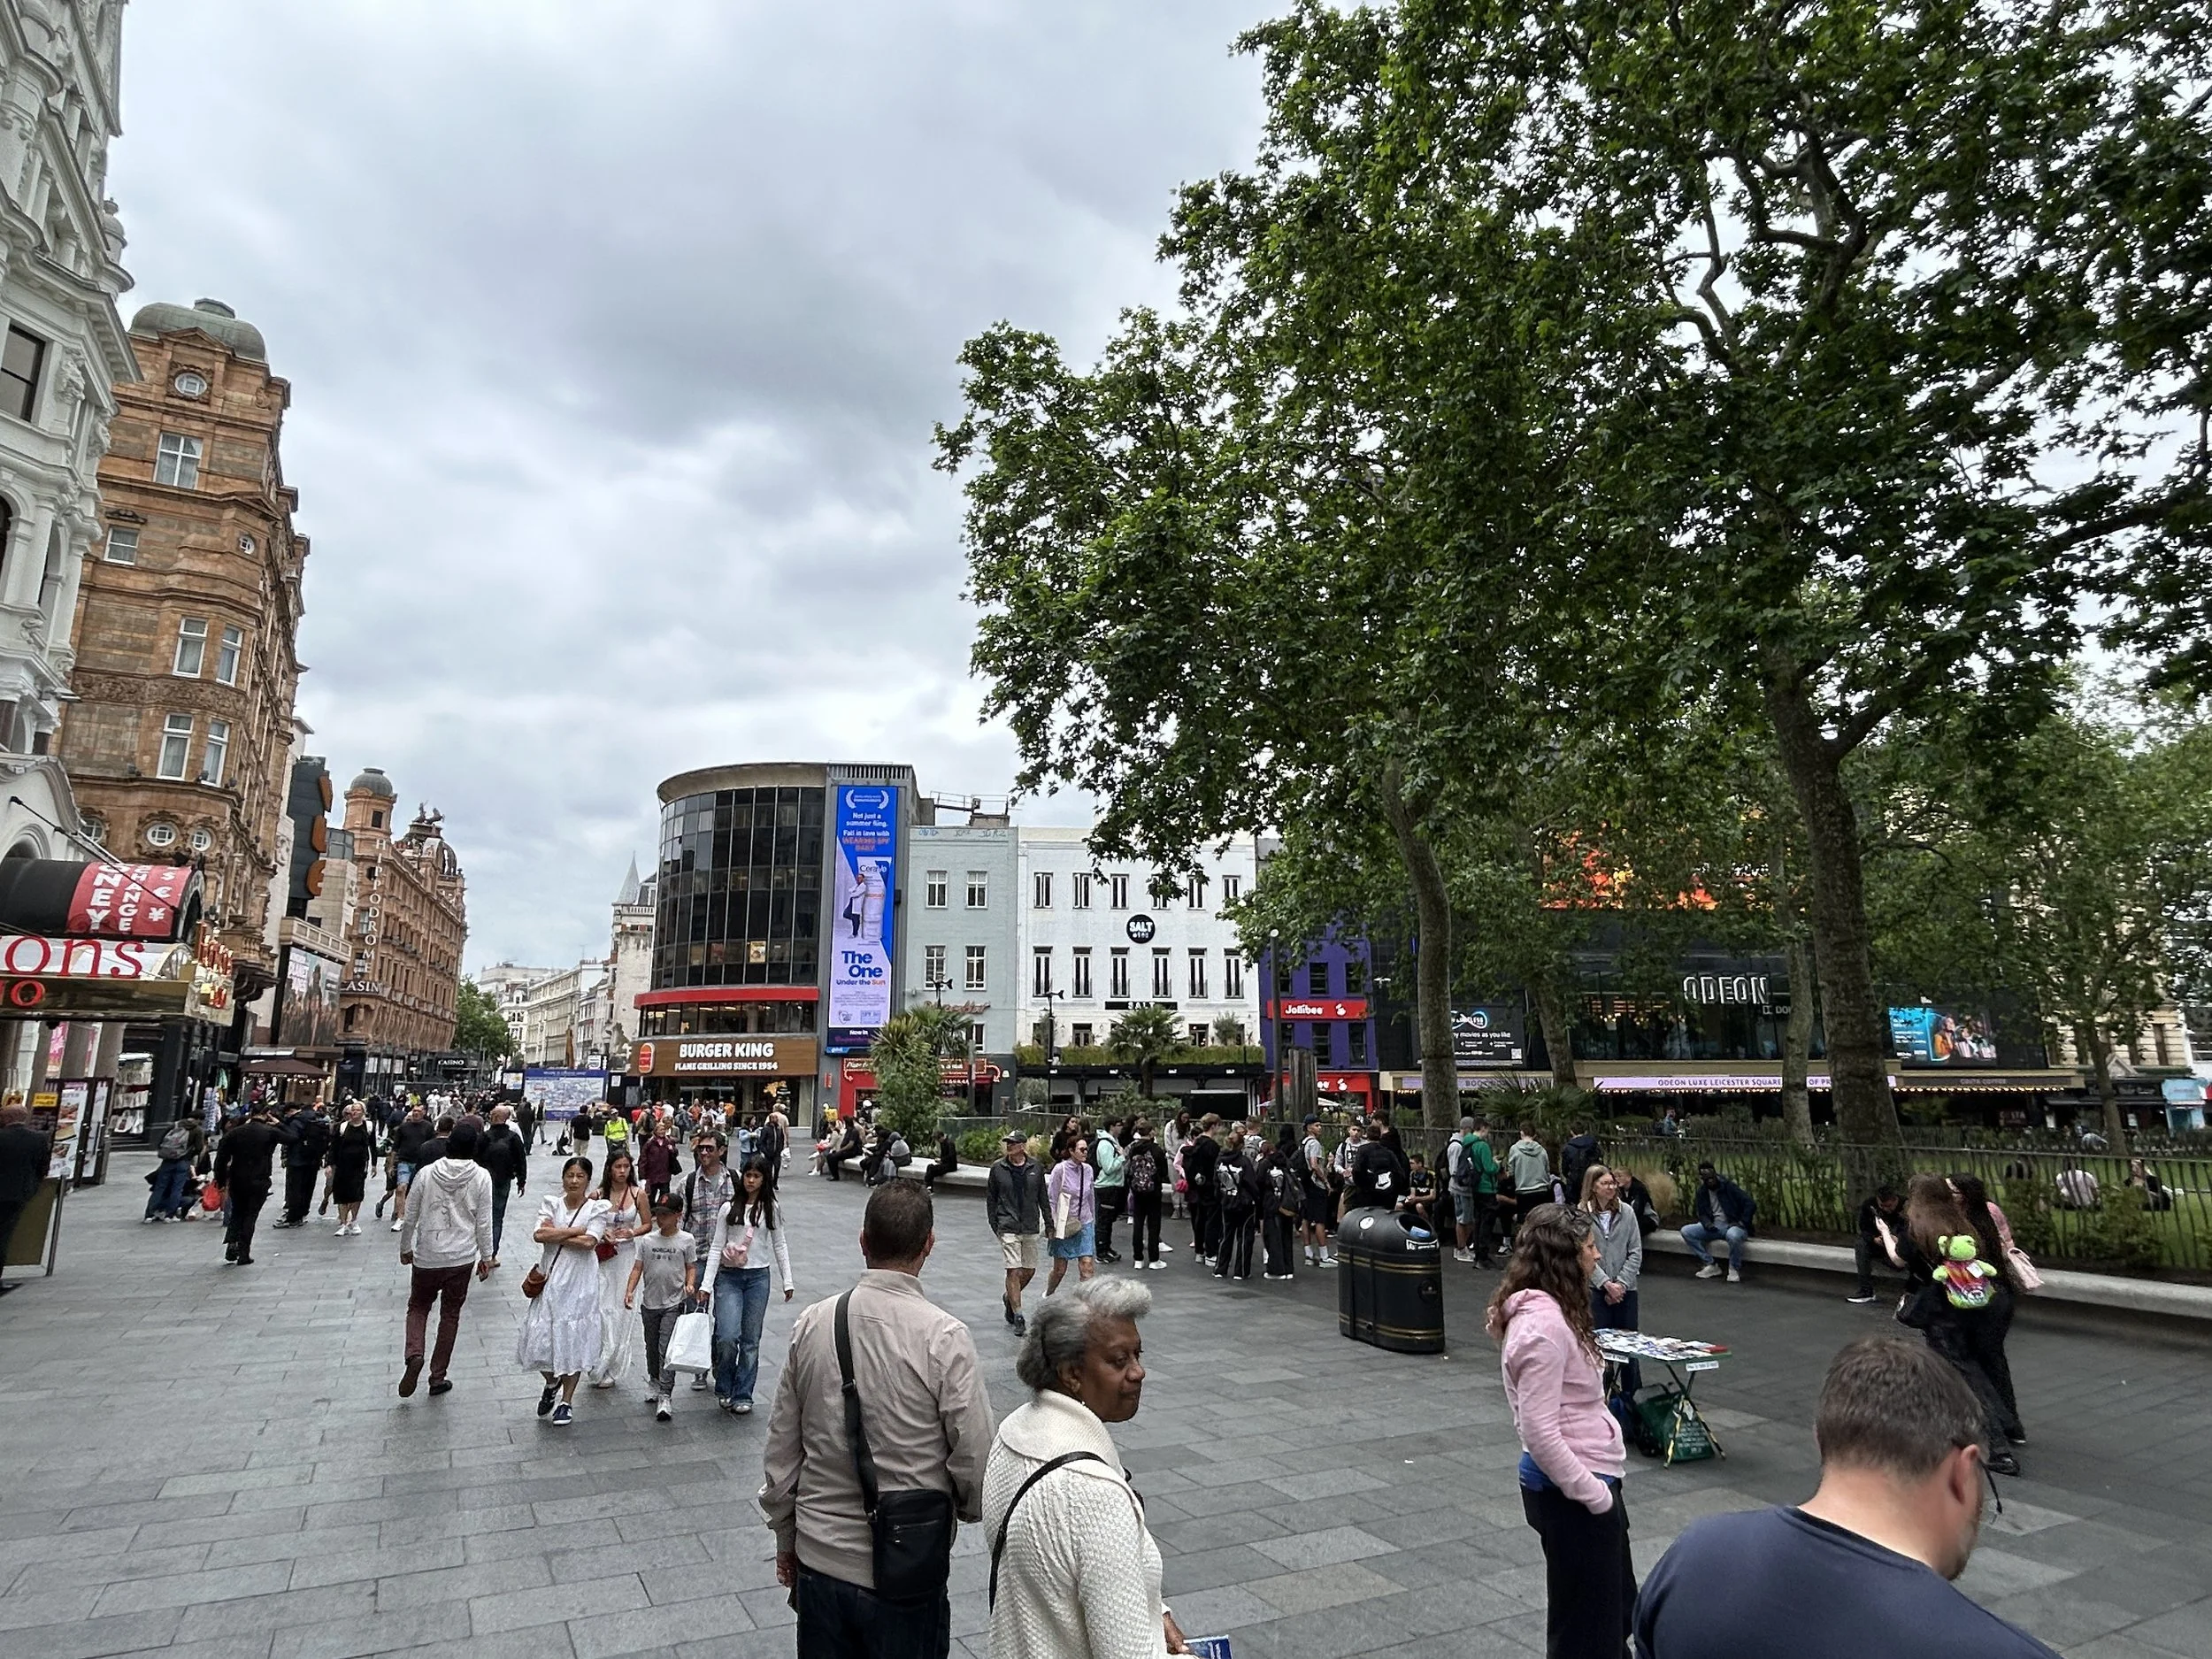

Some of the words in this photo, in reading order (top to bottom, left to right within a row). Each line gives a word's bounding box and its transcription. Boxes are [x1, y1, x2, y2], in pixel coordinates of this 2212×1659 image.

[86, 864, 131, 931] ONEY
[118, 864, 155, 932] CHANGE
[362, 838, 387, 973] HIPPODROME
[1129, 921, 1153, 933] SALT
[0, 935, 145, 979] ons
[841, 950, 873, 964] The
[849, 964, 883, 978] One
[1683, 976, 1769, 1004] ODEON
[1285, 1003, 1324, 1015] Jollibee
[679, 1043, 732, 1058] BURGER
[734, 1042, 774, 1058] KING
[697, 1062, 733, 1071] GRILLING
[733, 1062, 758, 1071] SINCE
[759, 1062, 779, 1071] 1954
[1809, 1078, 1819, 1087] OF
[1821, 1078, 1832, 1087] PR
